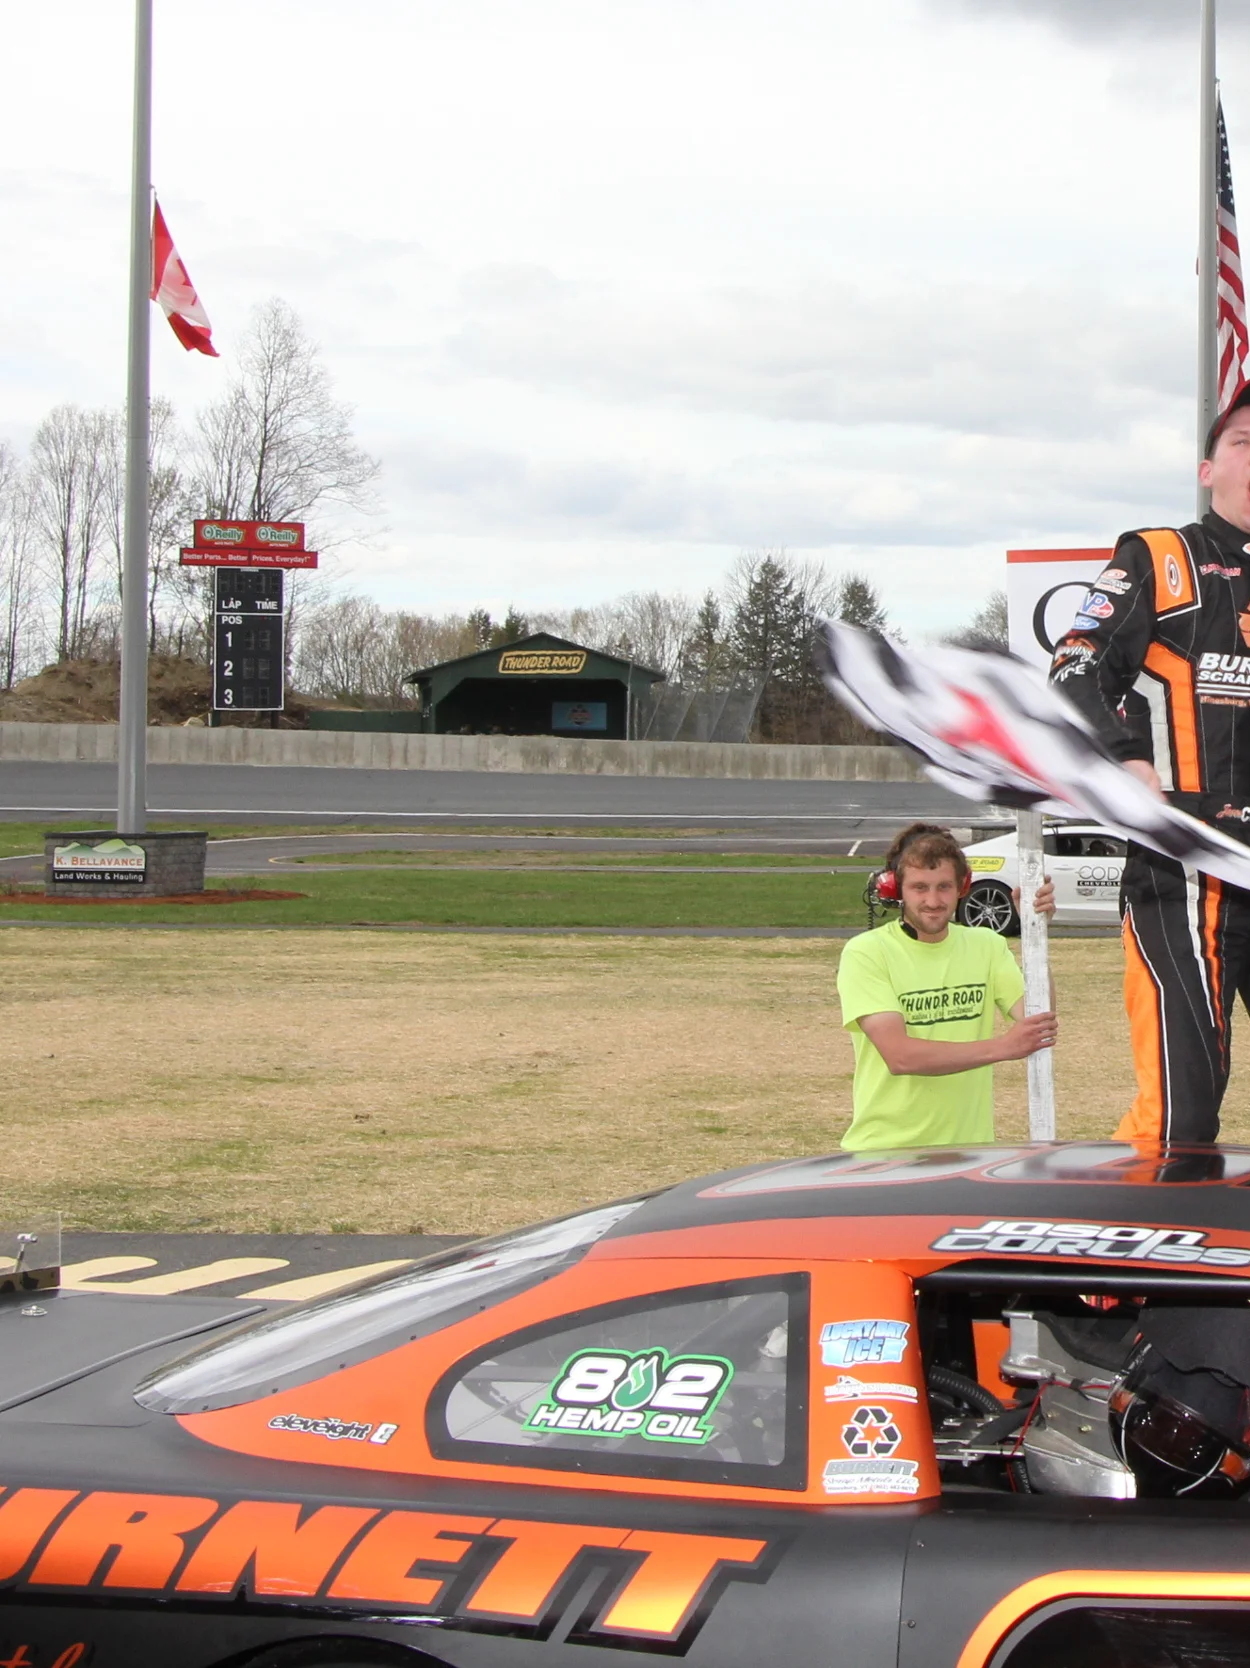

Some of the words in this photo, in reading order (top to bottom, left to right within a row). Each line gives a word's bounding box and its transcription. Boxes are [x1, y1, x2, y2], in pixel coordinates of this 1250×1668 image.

[203, 526, 243, 541] O'Reilly
[257, 528, 297, 543] O'Reilly
[222, 600, 242, 609] LAP
[255, 601, 278, 610] TIME
[222, 615, 242, 624] POS
[225, 631, 232, 647] 1
[224, 660, 233, 676] 2
[505, 656, 553, 669] THUNDER
[551, 656, 581, 668] ROAD
[224, 688, 233, 704] 3
[56, 856, 67, 865] K.
[71, 857, 143, 866] BELLAVANCE
[55, 872, 74, 880] Land
[76, 872, 102, 880] Works
[113, 873, 144, 882] Hauling
[952, 989, 983, 1007] ROAD
[821, 1321, 878, 1342] LUCKY
[873, 1321, 907, 1340] DAY
[843, 1338, 885, 1363] ICE
[269, 1415, 371, 1439] eleveight
[530, 1404, 645, 1433] HEMP
[646, 1413, 704, 1438] OIL
[825, 1461, 916, 1476] BURNETT
